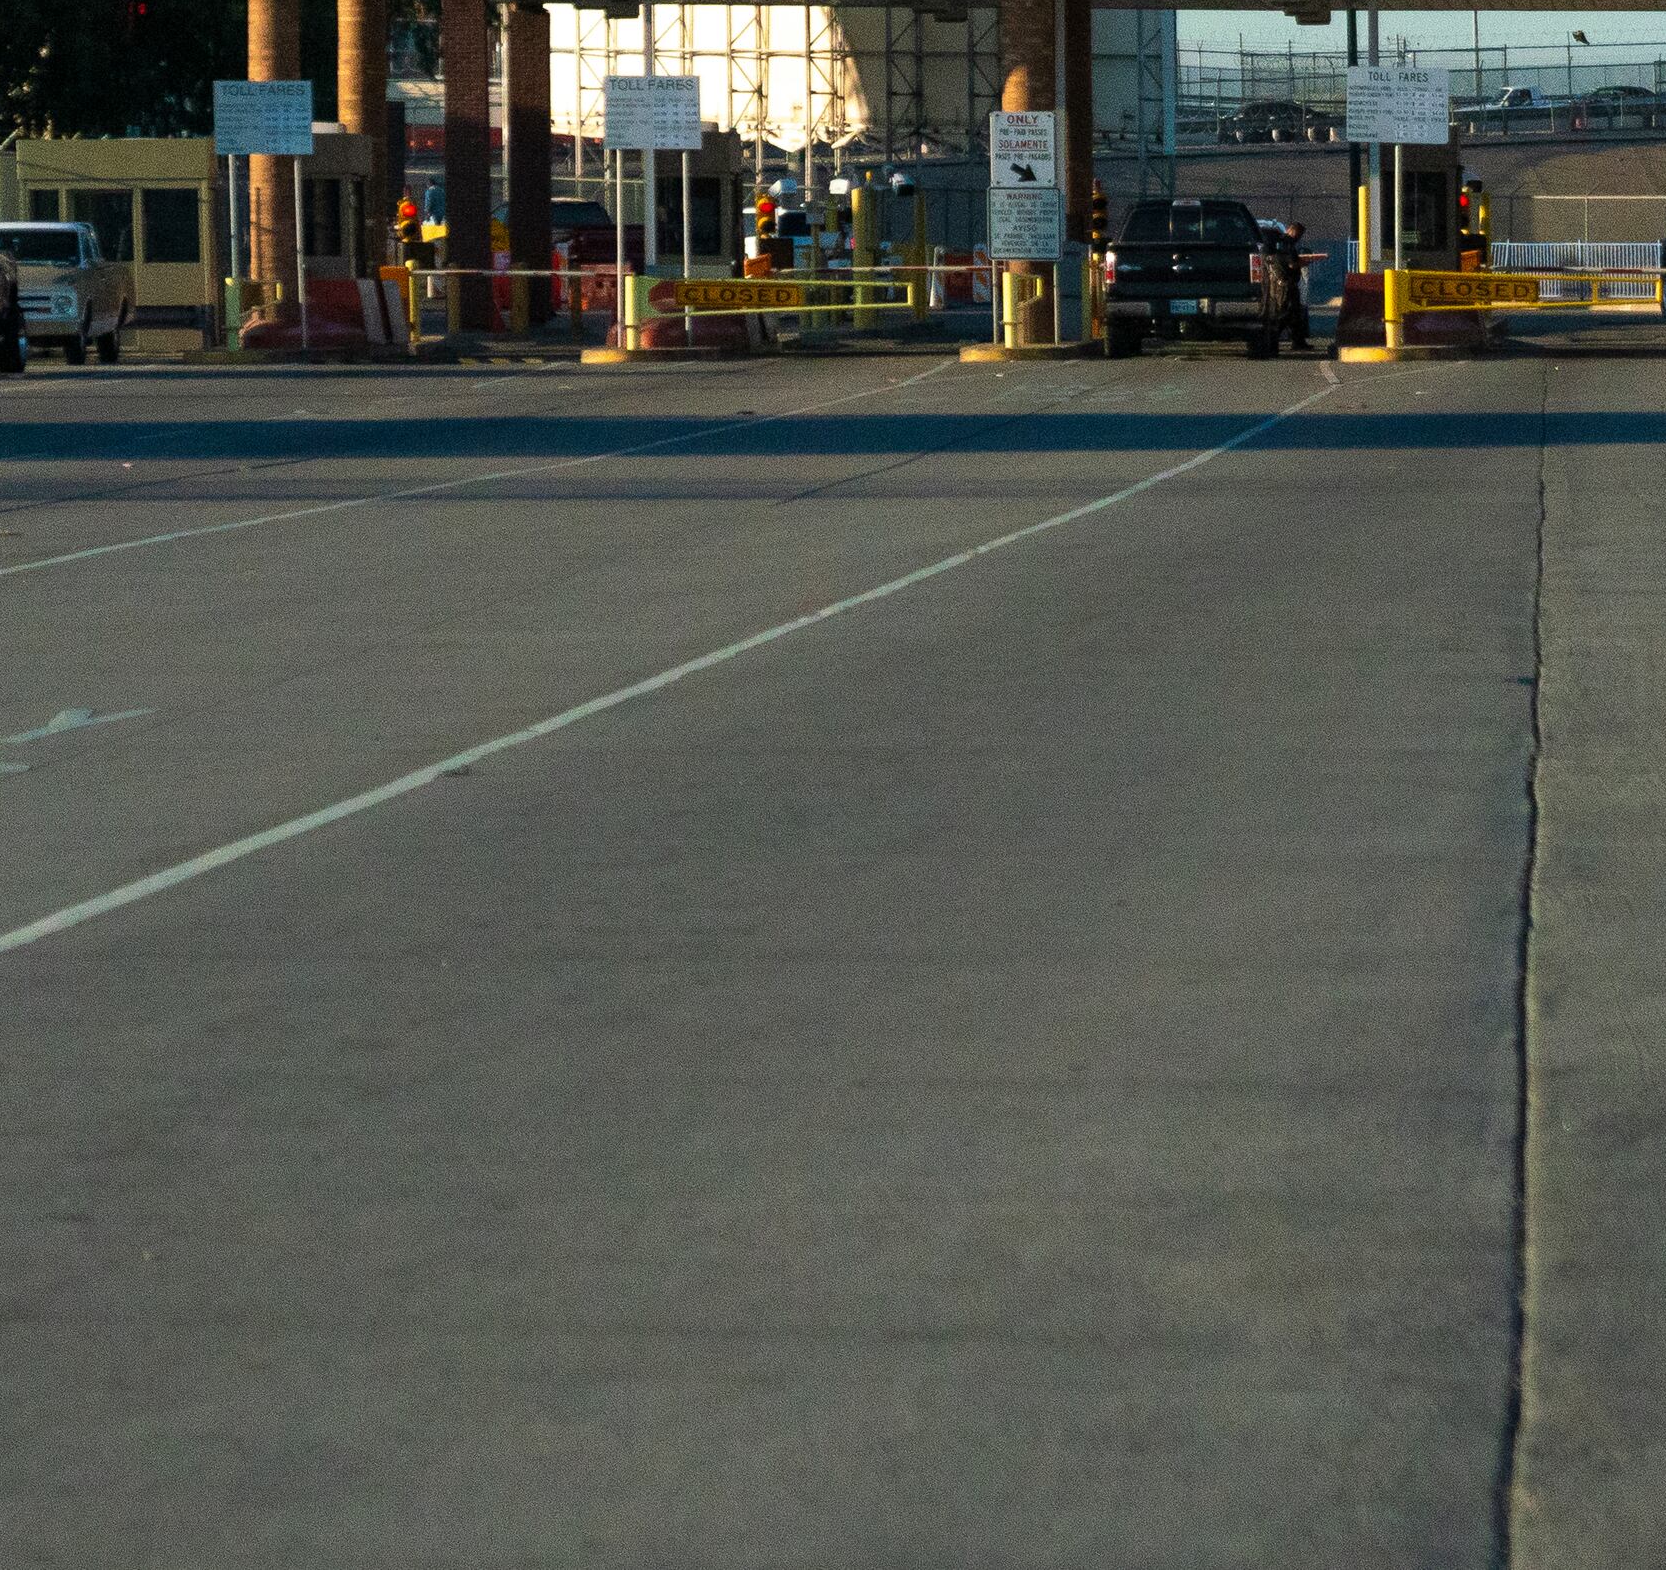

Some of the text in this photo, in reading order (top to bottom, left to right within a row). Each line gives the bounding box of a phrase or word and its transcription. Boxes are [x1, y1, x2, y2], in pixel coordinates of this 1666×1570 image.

[1368, 71, 1429, 83] TOLL FARES
[222, 84, 305, 96] TOLL FARES
[610, 79, 694, 91] TOLL FARES
[1007, 115, 1039, 124] ONLY
[998, 140, 1048, 149] SOLAMENTE
[685, 288, 791, 303] CLOSED
[1420, 281, 1531, 298] CLOSED
